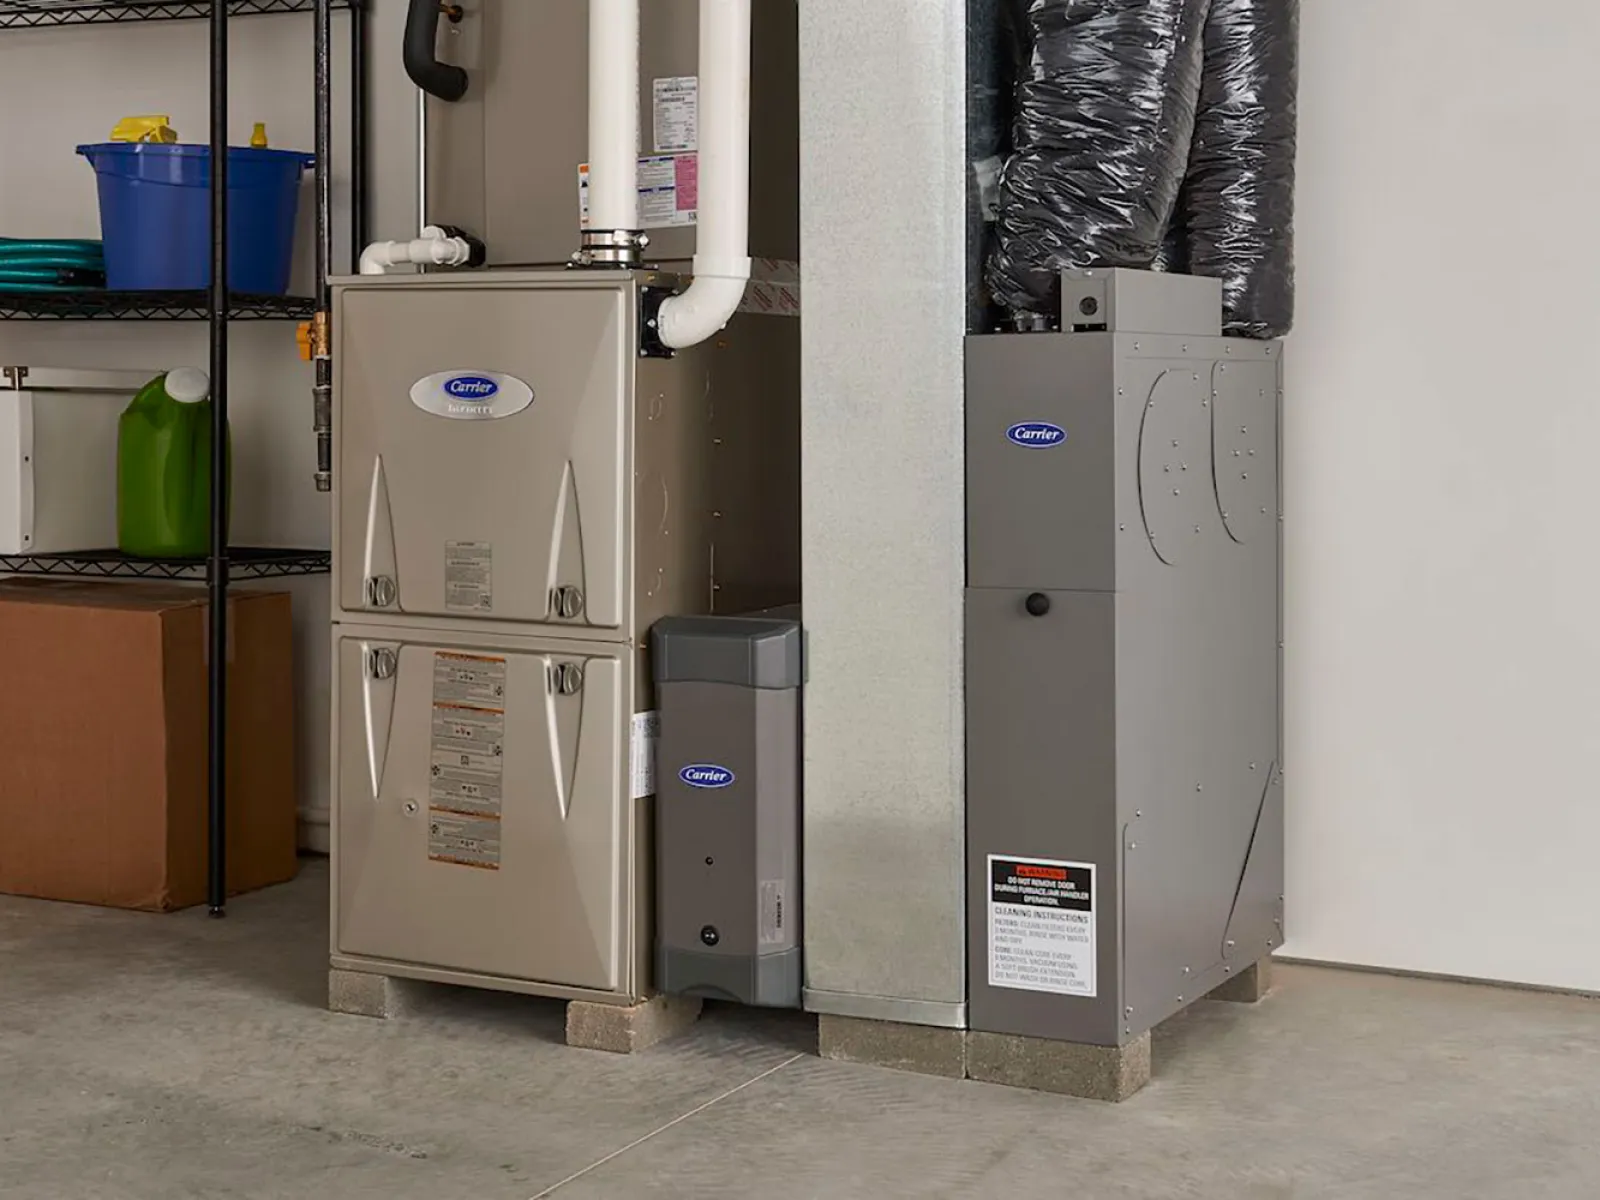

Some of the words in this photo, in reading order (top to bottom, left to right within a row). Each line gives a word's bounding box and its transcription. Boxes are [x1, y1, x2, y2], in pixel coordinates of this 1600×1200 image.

[450, 380, 493, 393] Carrier
[1014, 426, 1060, 440] Carrier
[685, 768, 728, 781] Carrier
[1007, 876, 1018, 884] DO
[1018, 877, 1031, 885] NOT
[1031, 878, 1056, 888] REMOVE
[1057, 880, 1076, 890] DOOR
[994, 883, 1018, 893] DURING
[1060, 889, 1090, 900] HANDLER
[995, 906, 1032, 917] CLEANING
[1034, 911, 1089, 924] INSTRUCTIONS
